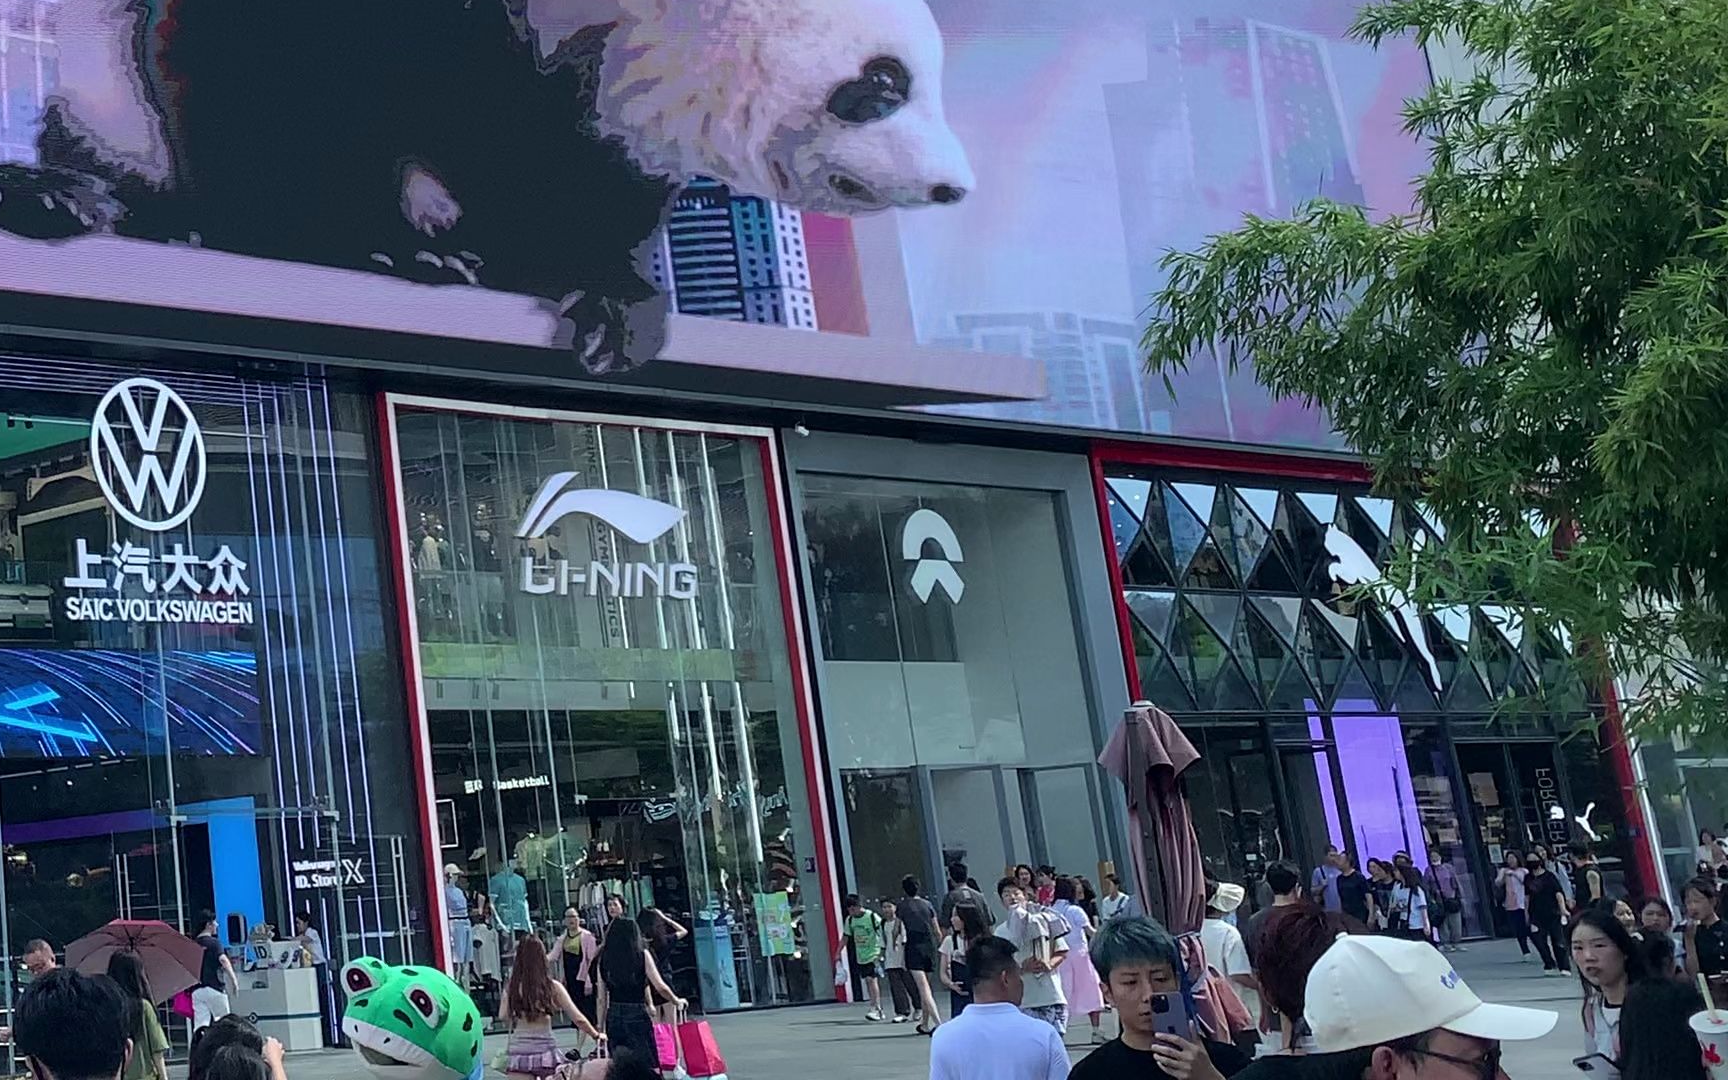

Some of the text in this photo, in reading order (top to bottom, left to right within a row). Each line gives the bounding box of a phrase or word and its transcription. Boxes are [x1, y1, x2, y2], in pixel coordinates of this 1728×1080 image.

[64, 538, 250, 596] 上汽大众
[521, 556, 699, 600] LI-NING
[66, 598, 254, 625] SAIC VOLKSWAGEN
